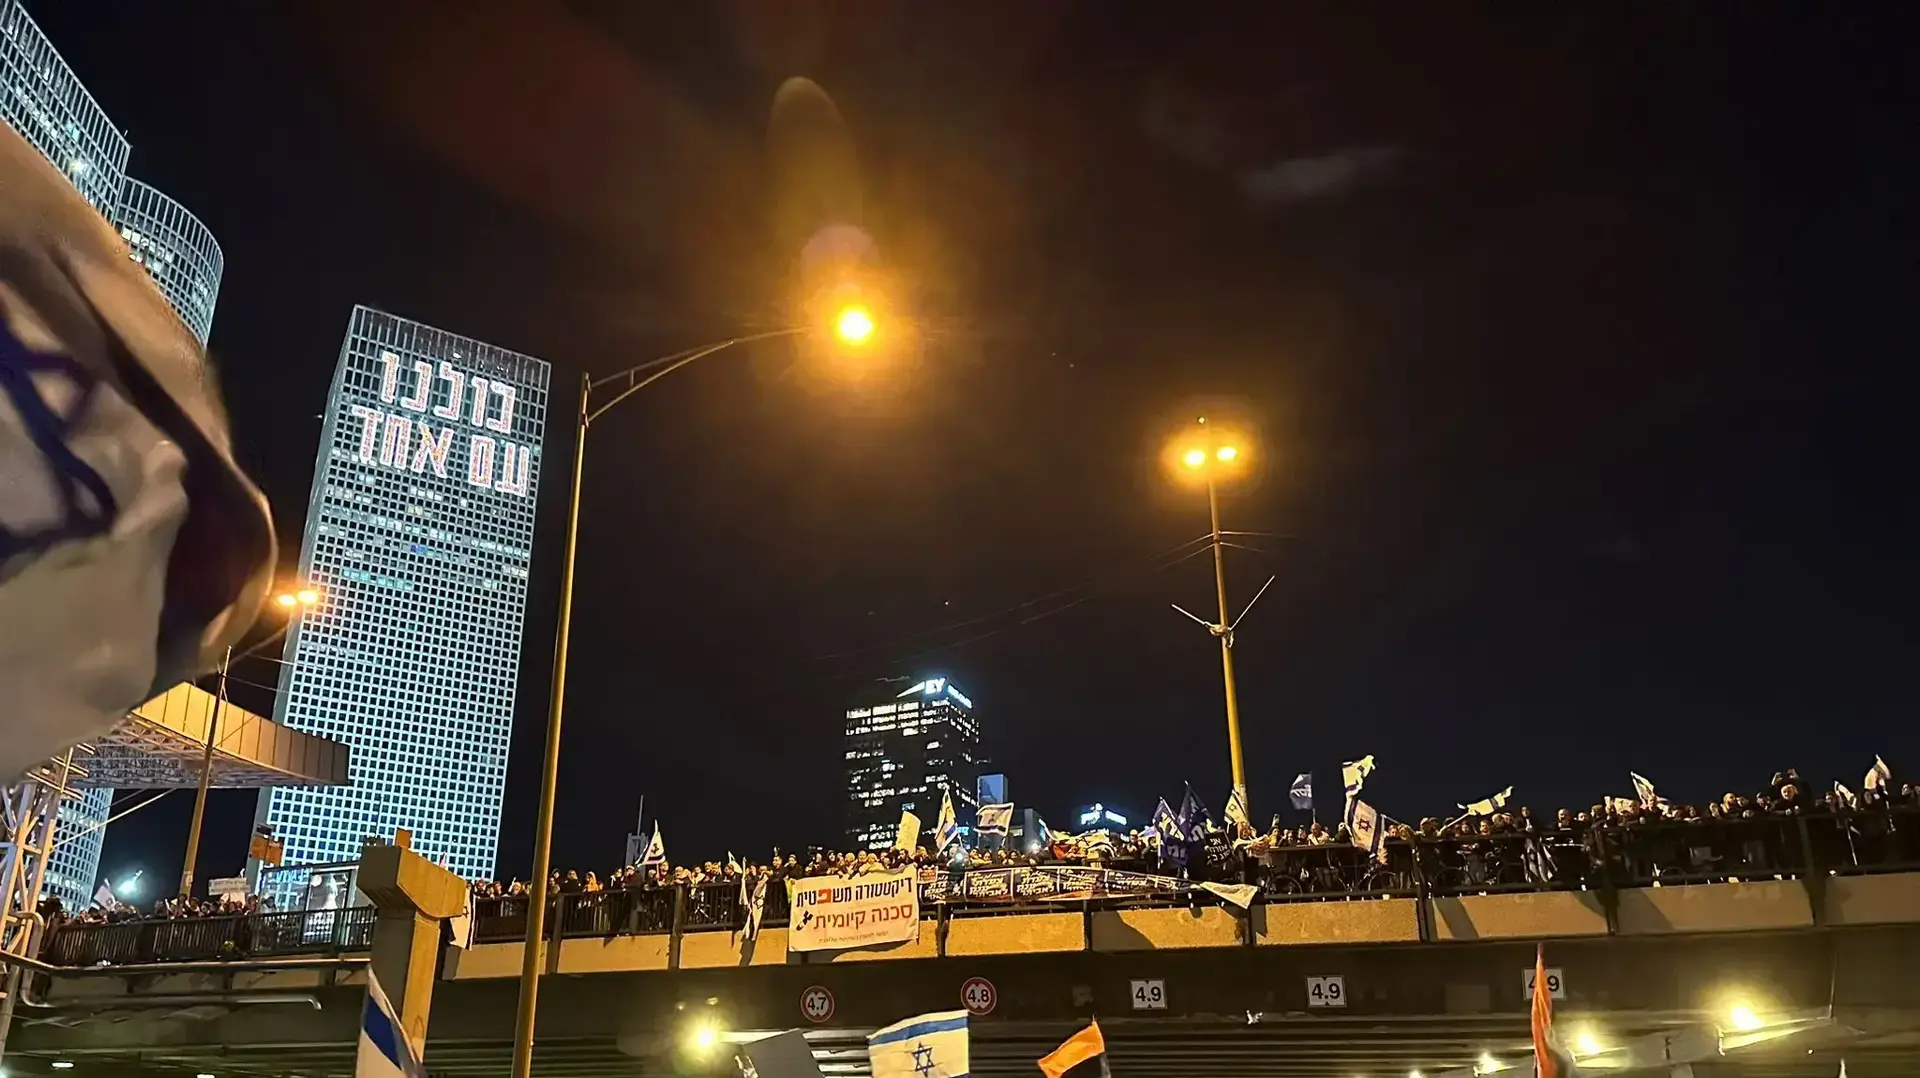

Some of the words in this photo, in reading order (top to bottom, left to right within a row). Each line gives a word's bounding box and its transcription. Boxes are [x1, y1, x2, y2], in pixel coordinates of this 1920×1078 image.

[381, 350, 517, 435] כולנו
[351, 403, 455, 479] אחד
[468, 434, 530, 497] עם
[925, 677, 946, 694] EY
[796, 886, 852, 908] משפטית
[855, 877, 913, 901] דיקטטורה
[813, 910, 866, 931] קיומית
[871, 903, 913, 923] סכנה
[967, 988, 990, 1003] 4.8
[1135, 986, 1162, 1002] 4.9
[1311, 983, 1341, 999] 4.9
[807, 996, 827, 1011] 4.7
